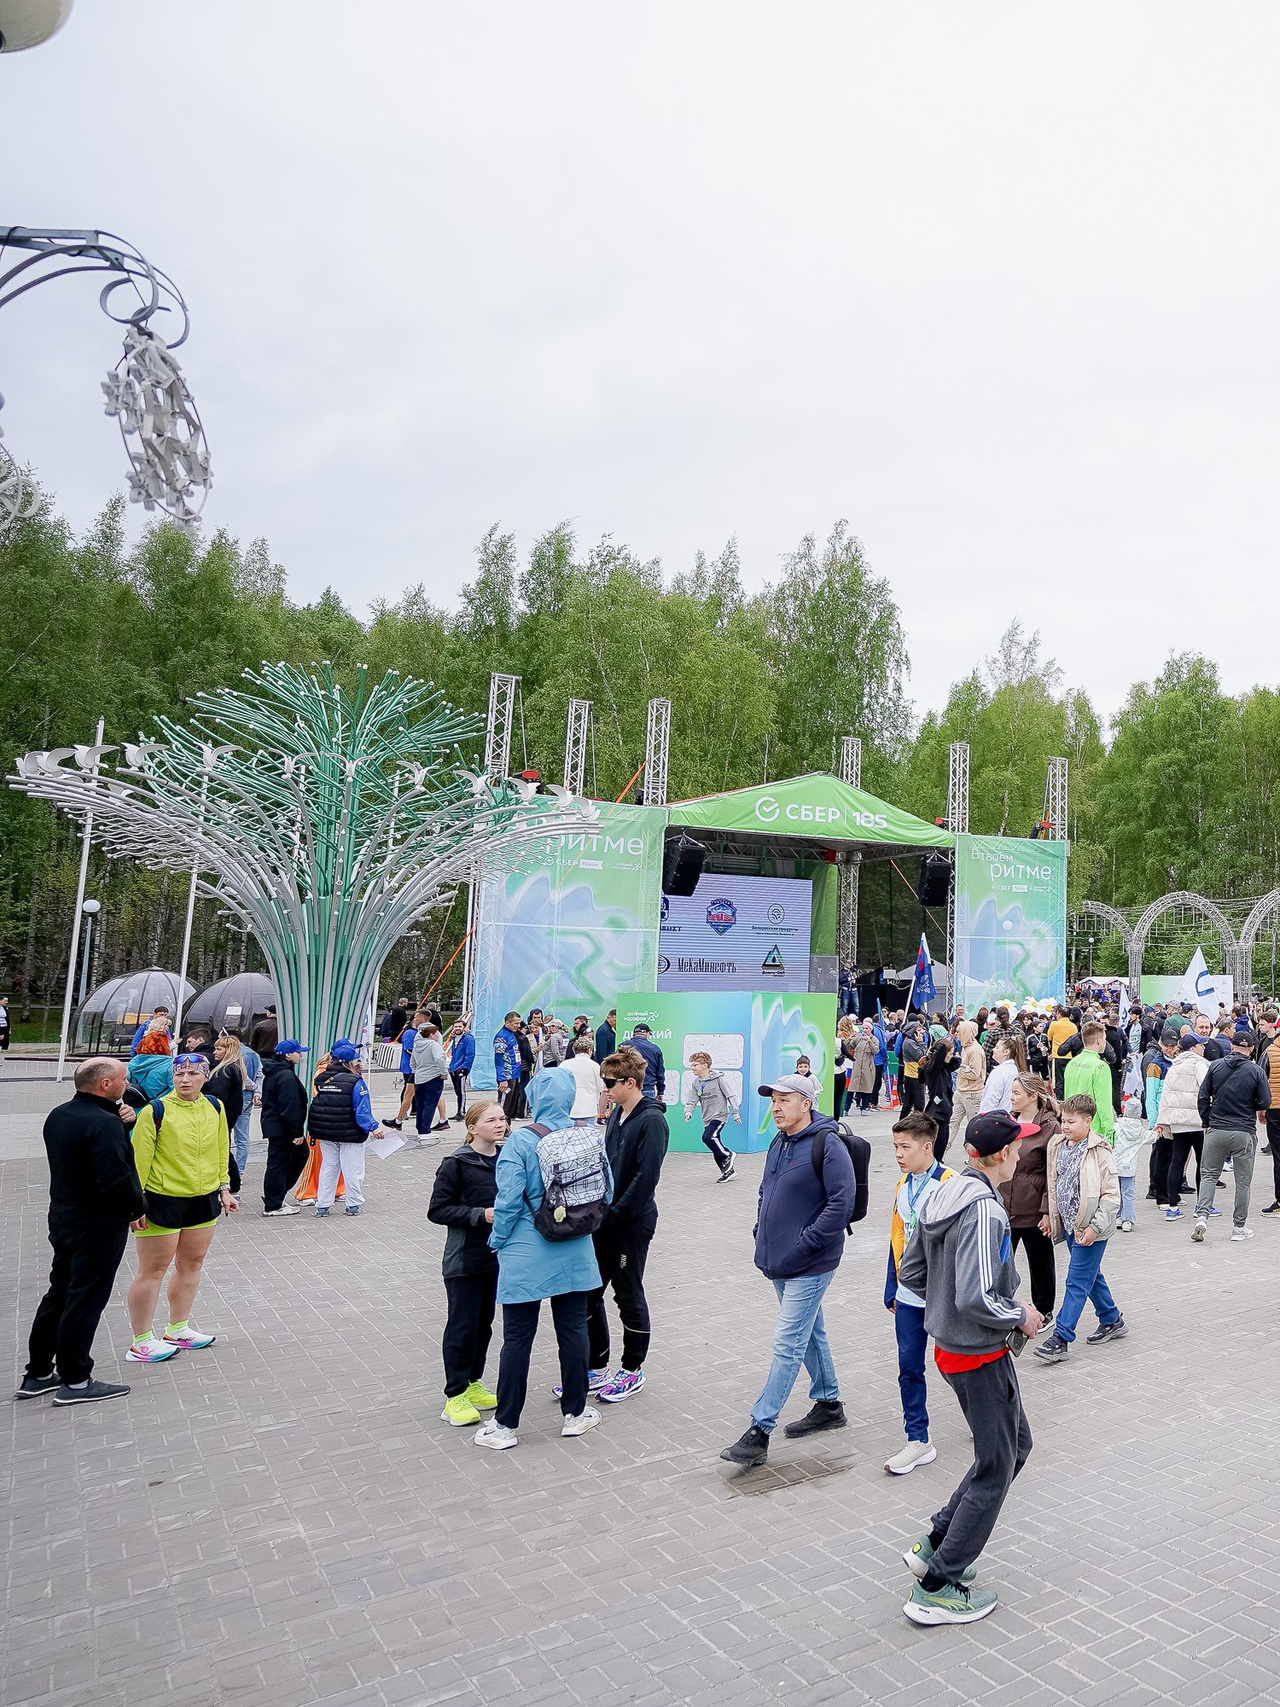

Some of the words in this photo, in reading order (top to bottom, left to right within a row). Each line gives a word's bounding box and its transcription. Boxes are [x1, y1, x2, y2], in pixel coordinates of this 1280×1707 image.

[786, 804, 840, 823] СБЕР
[853, 811, 888, 829] 185
[990, 863, 1052, 882] ритме
[622, 1028, 672, 1042] ДКИЙ
